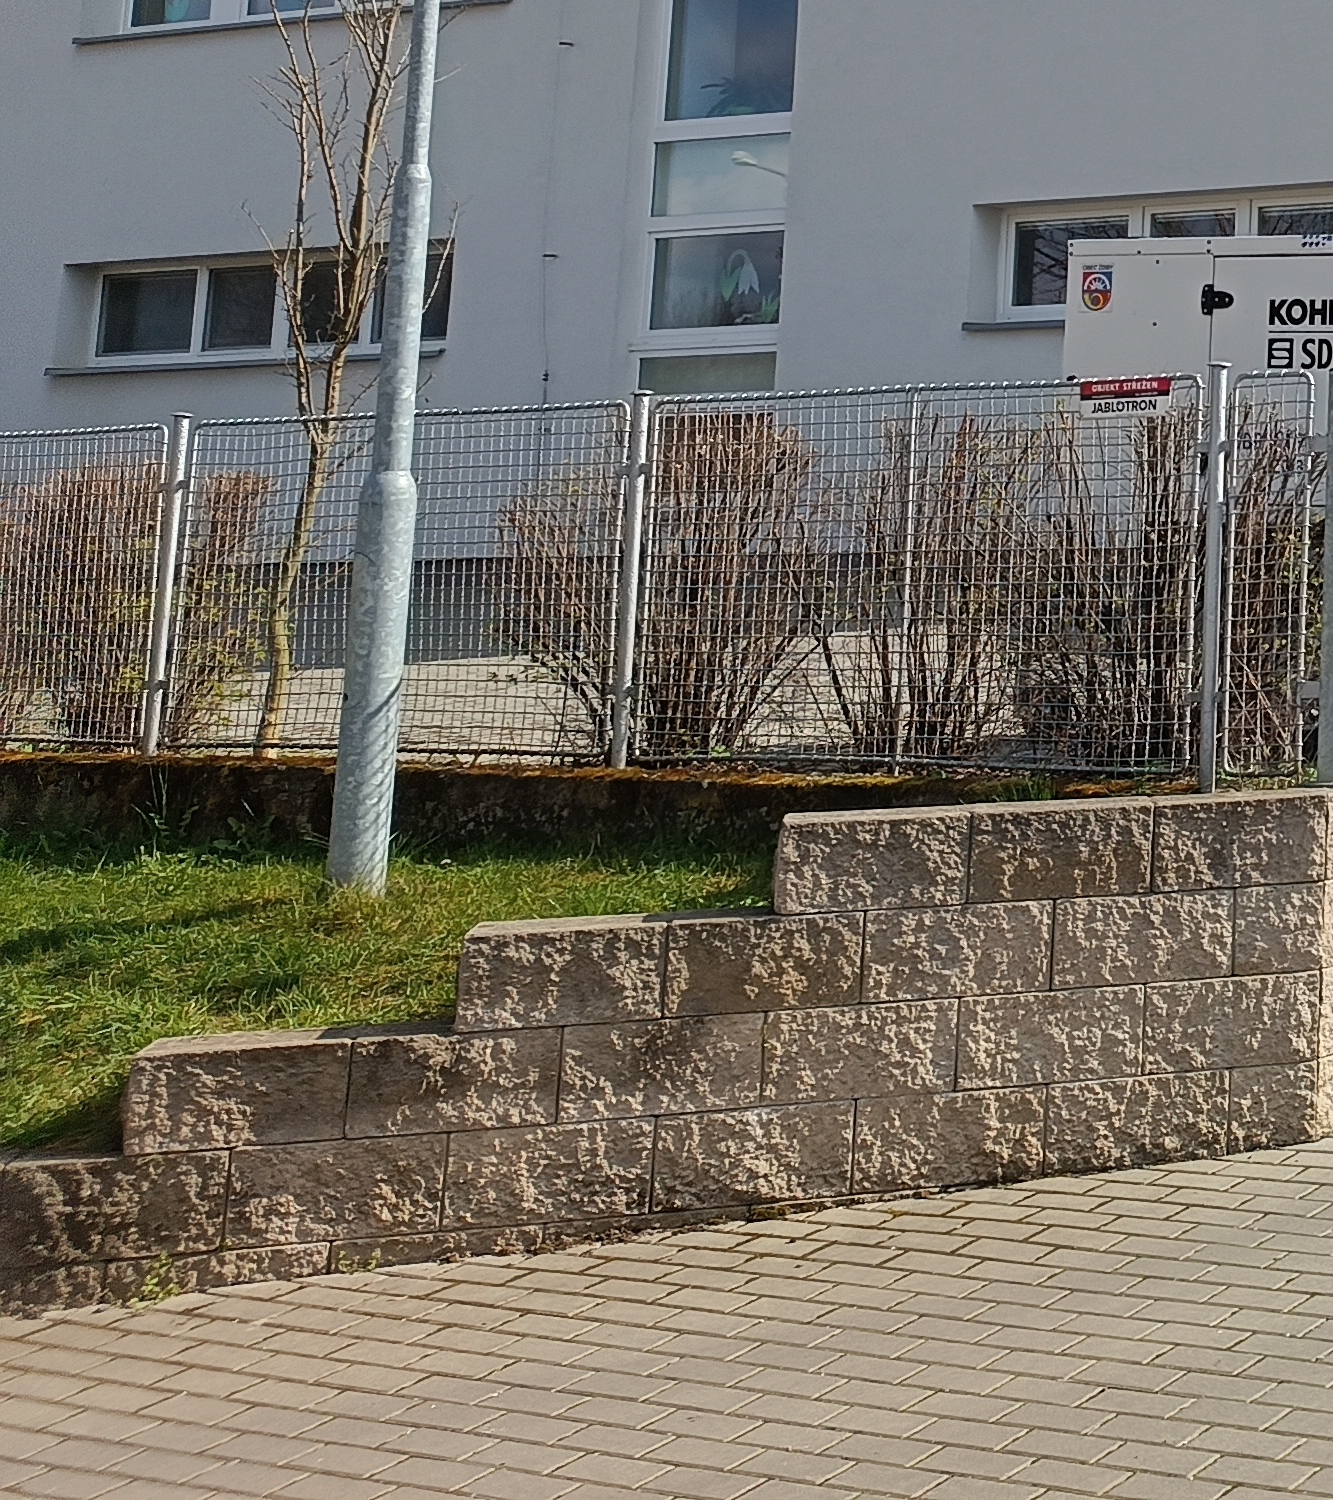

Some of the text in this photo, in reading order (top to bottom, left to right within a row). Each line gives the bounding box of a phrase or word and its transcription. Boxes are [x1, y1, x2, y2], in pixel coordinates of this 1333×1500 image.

[1091, 380, 1158, 393] OBJEKT STŘEŽEN
[1091, 399, 1158, 414] JABLOTRON
